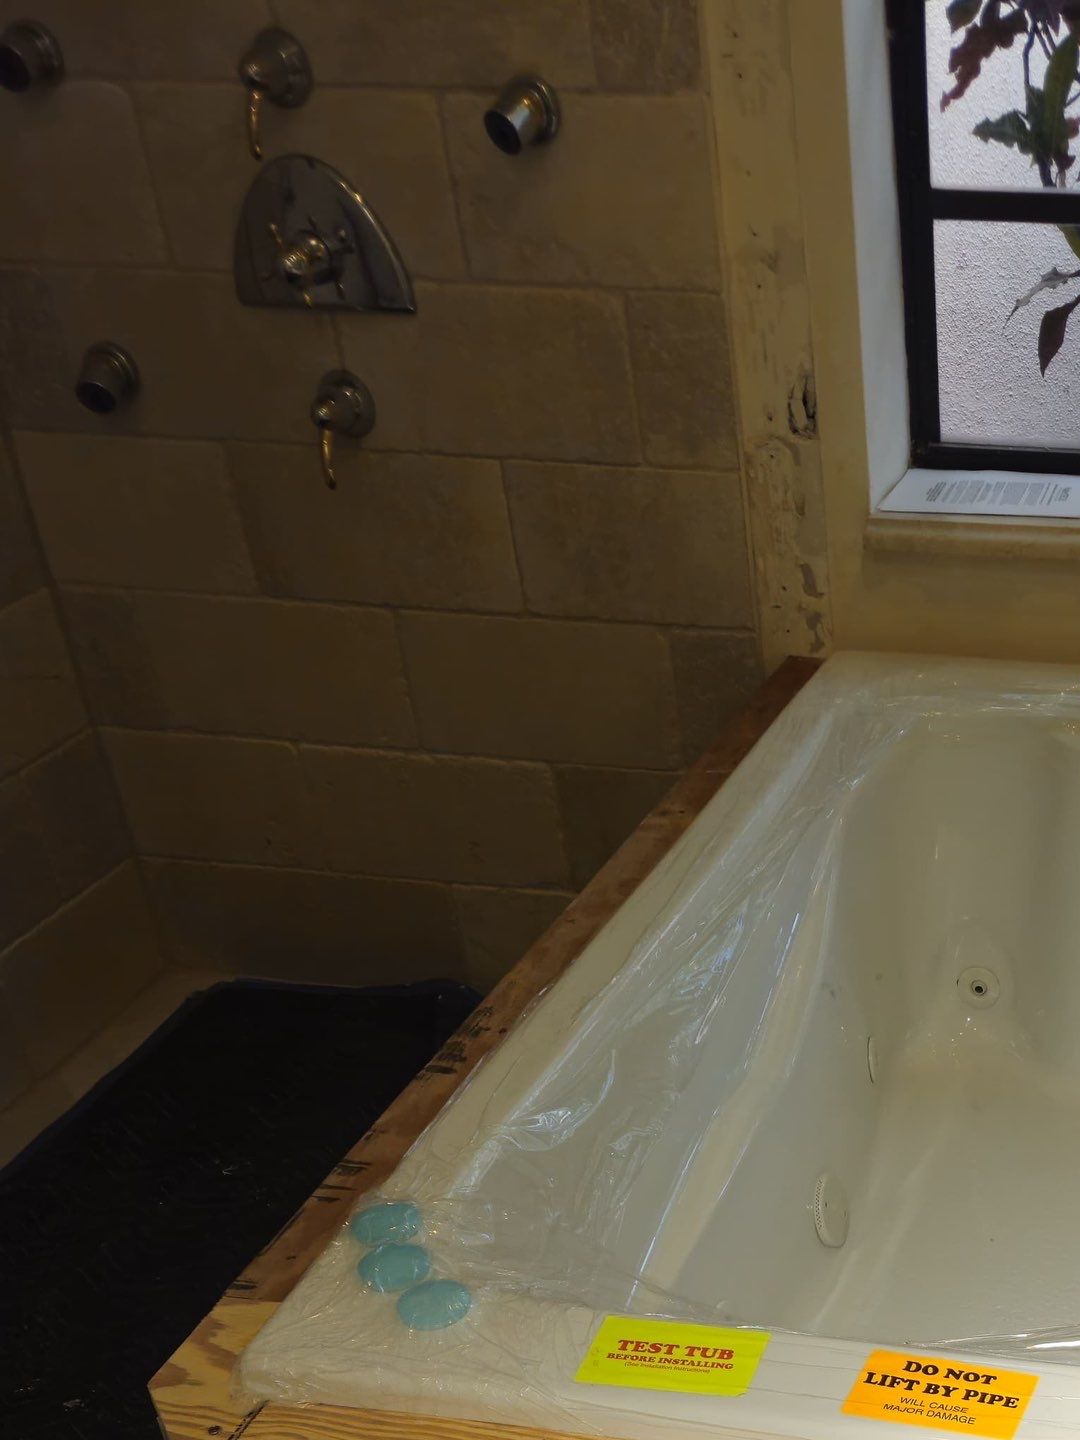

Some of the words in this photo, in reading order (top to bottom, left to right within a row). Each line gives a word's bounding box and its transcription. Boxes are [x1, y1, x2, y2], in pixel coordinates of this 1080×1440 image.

[618, 1339, 680, 1355] TEST
[685, 1346, 734, 1360] TUB
[606, 1352, 656, 1363] BEFORE
[658, 1357, 734, 1370] INSTALLING
[902, 1360, 939, 1376] DO
[943, 1368, 997, 1385] NOT
[863, 1371, 920, 1391] LIFT
[922, 1382, 959, 1398] BY
[961, 1388, 1020, 1409] PIPE
[883, 1403, 925, 1416] MAJOR
[926, 1409, 976, 1425] DAMAGE
[900, 1396, 925, 1408] WILL
[929, 1401, 969, 1414] CAUSE
